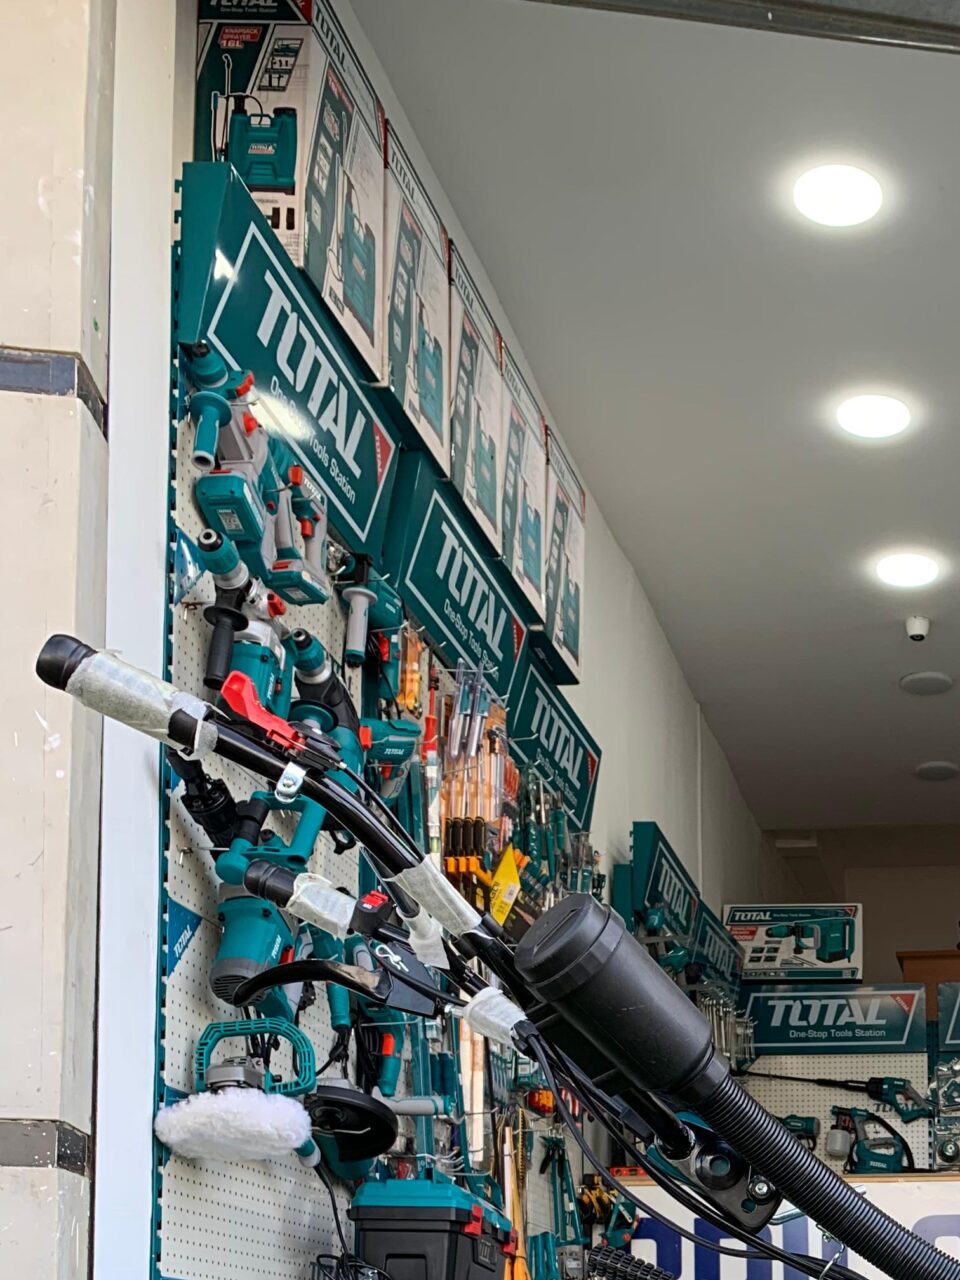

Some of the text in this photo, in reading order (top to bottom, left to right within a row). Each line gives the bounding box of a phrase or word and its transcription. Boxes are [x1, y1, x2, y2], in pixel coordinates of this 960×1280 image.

[315, 5, 347, 73] TOTAL
[257, 269, 367, 480] TOTAL
[309, 429, 356, 506] Tools Station
[435, 520, 508, 662] TOTAL
[443, 598, 469, 644] One-Stop
[468, 630, 483, 659] Tools
[384, 747, 405, 756] TOTAL
[530, 686, 583, 790] TOTAL
[658, 857, 691, 928] TOTAL
[733, 911, 773, 921] TOTAL
[172, 925, 194, 959] TOTAL
[703, 925, 736, 982] TOTAL
[767, 998, 888, 1027] TOTAL
[789, 1028, 887, 1040] One-Stop Tools Station
